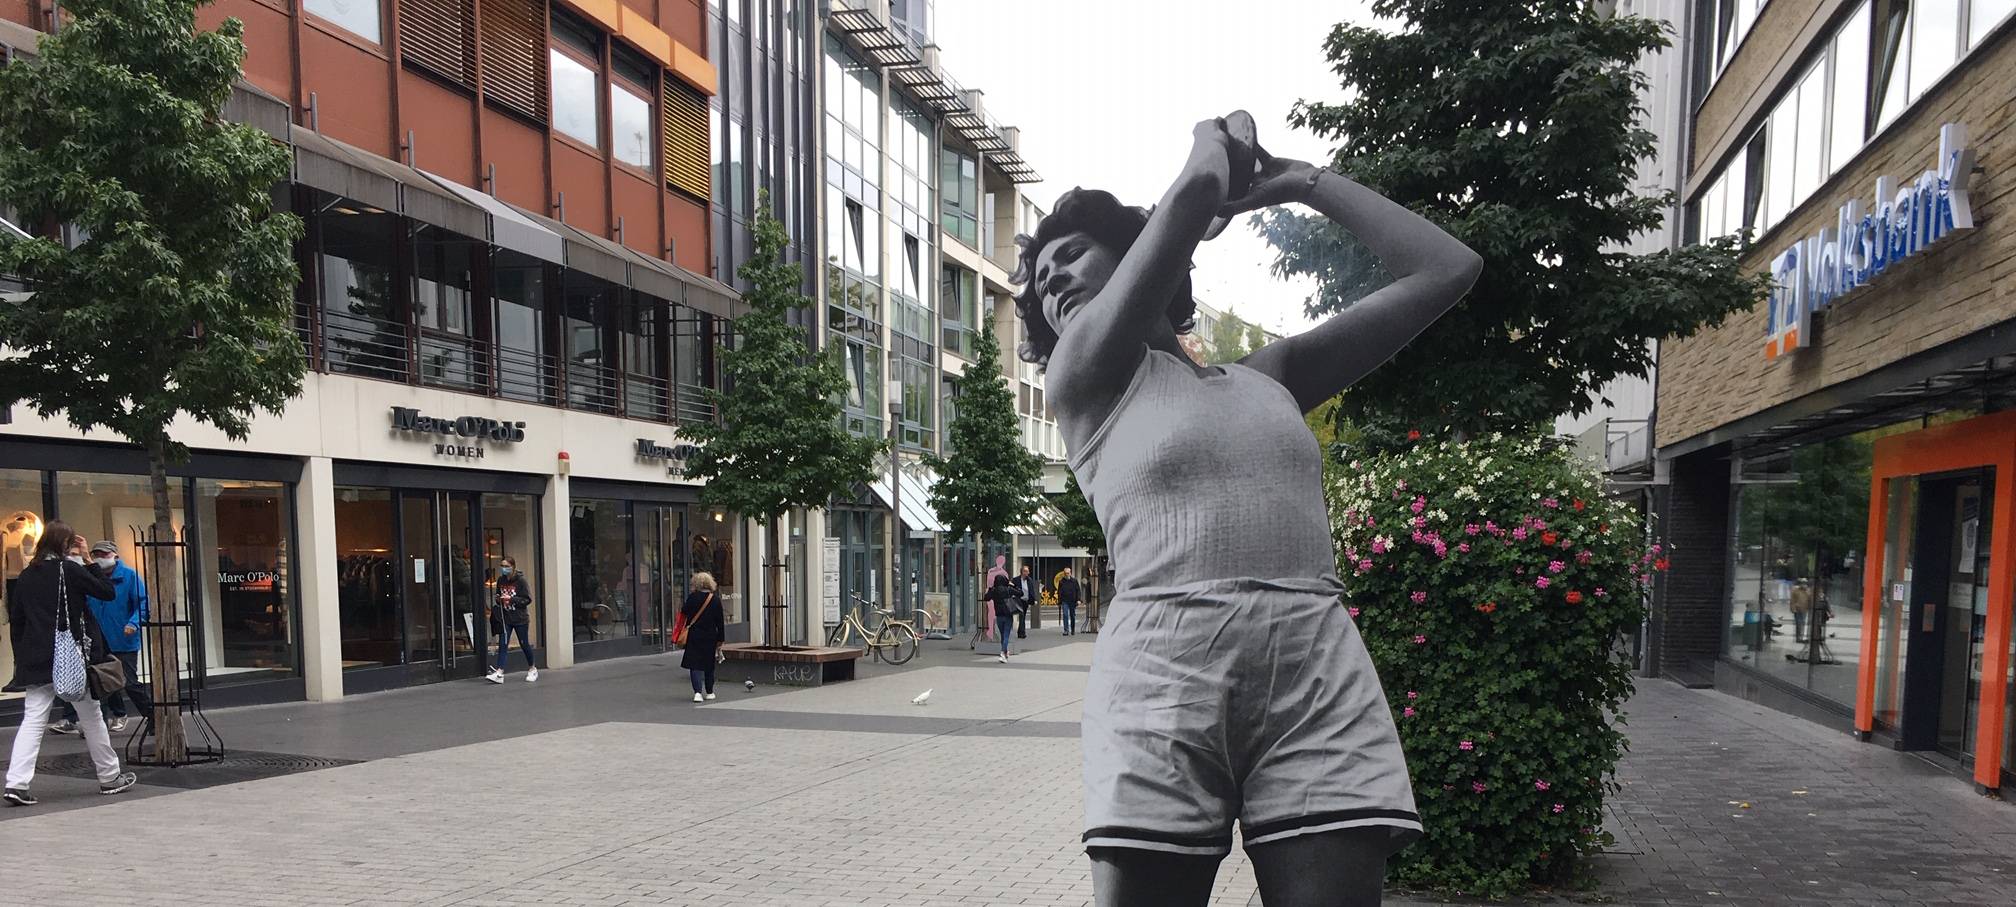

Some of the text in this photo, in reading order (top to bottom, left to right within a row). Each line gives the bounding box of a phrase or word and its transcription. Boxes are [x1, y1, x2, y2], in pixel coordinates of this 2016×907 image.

[1806, 123, 1976, 312] Volksbank
[390, 406, 456, 435] Marc
[434, 443, 484, 458] WOMEN
[636, 438, 676, 460] Marc
[217, 571, 280, 583] Marc O'Polo
